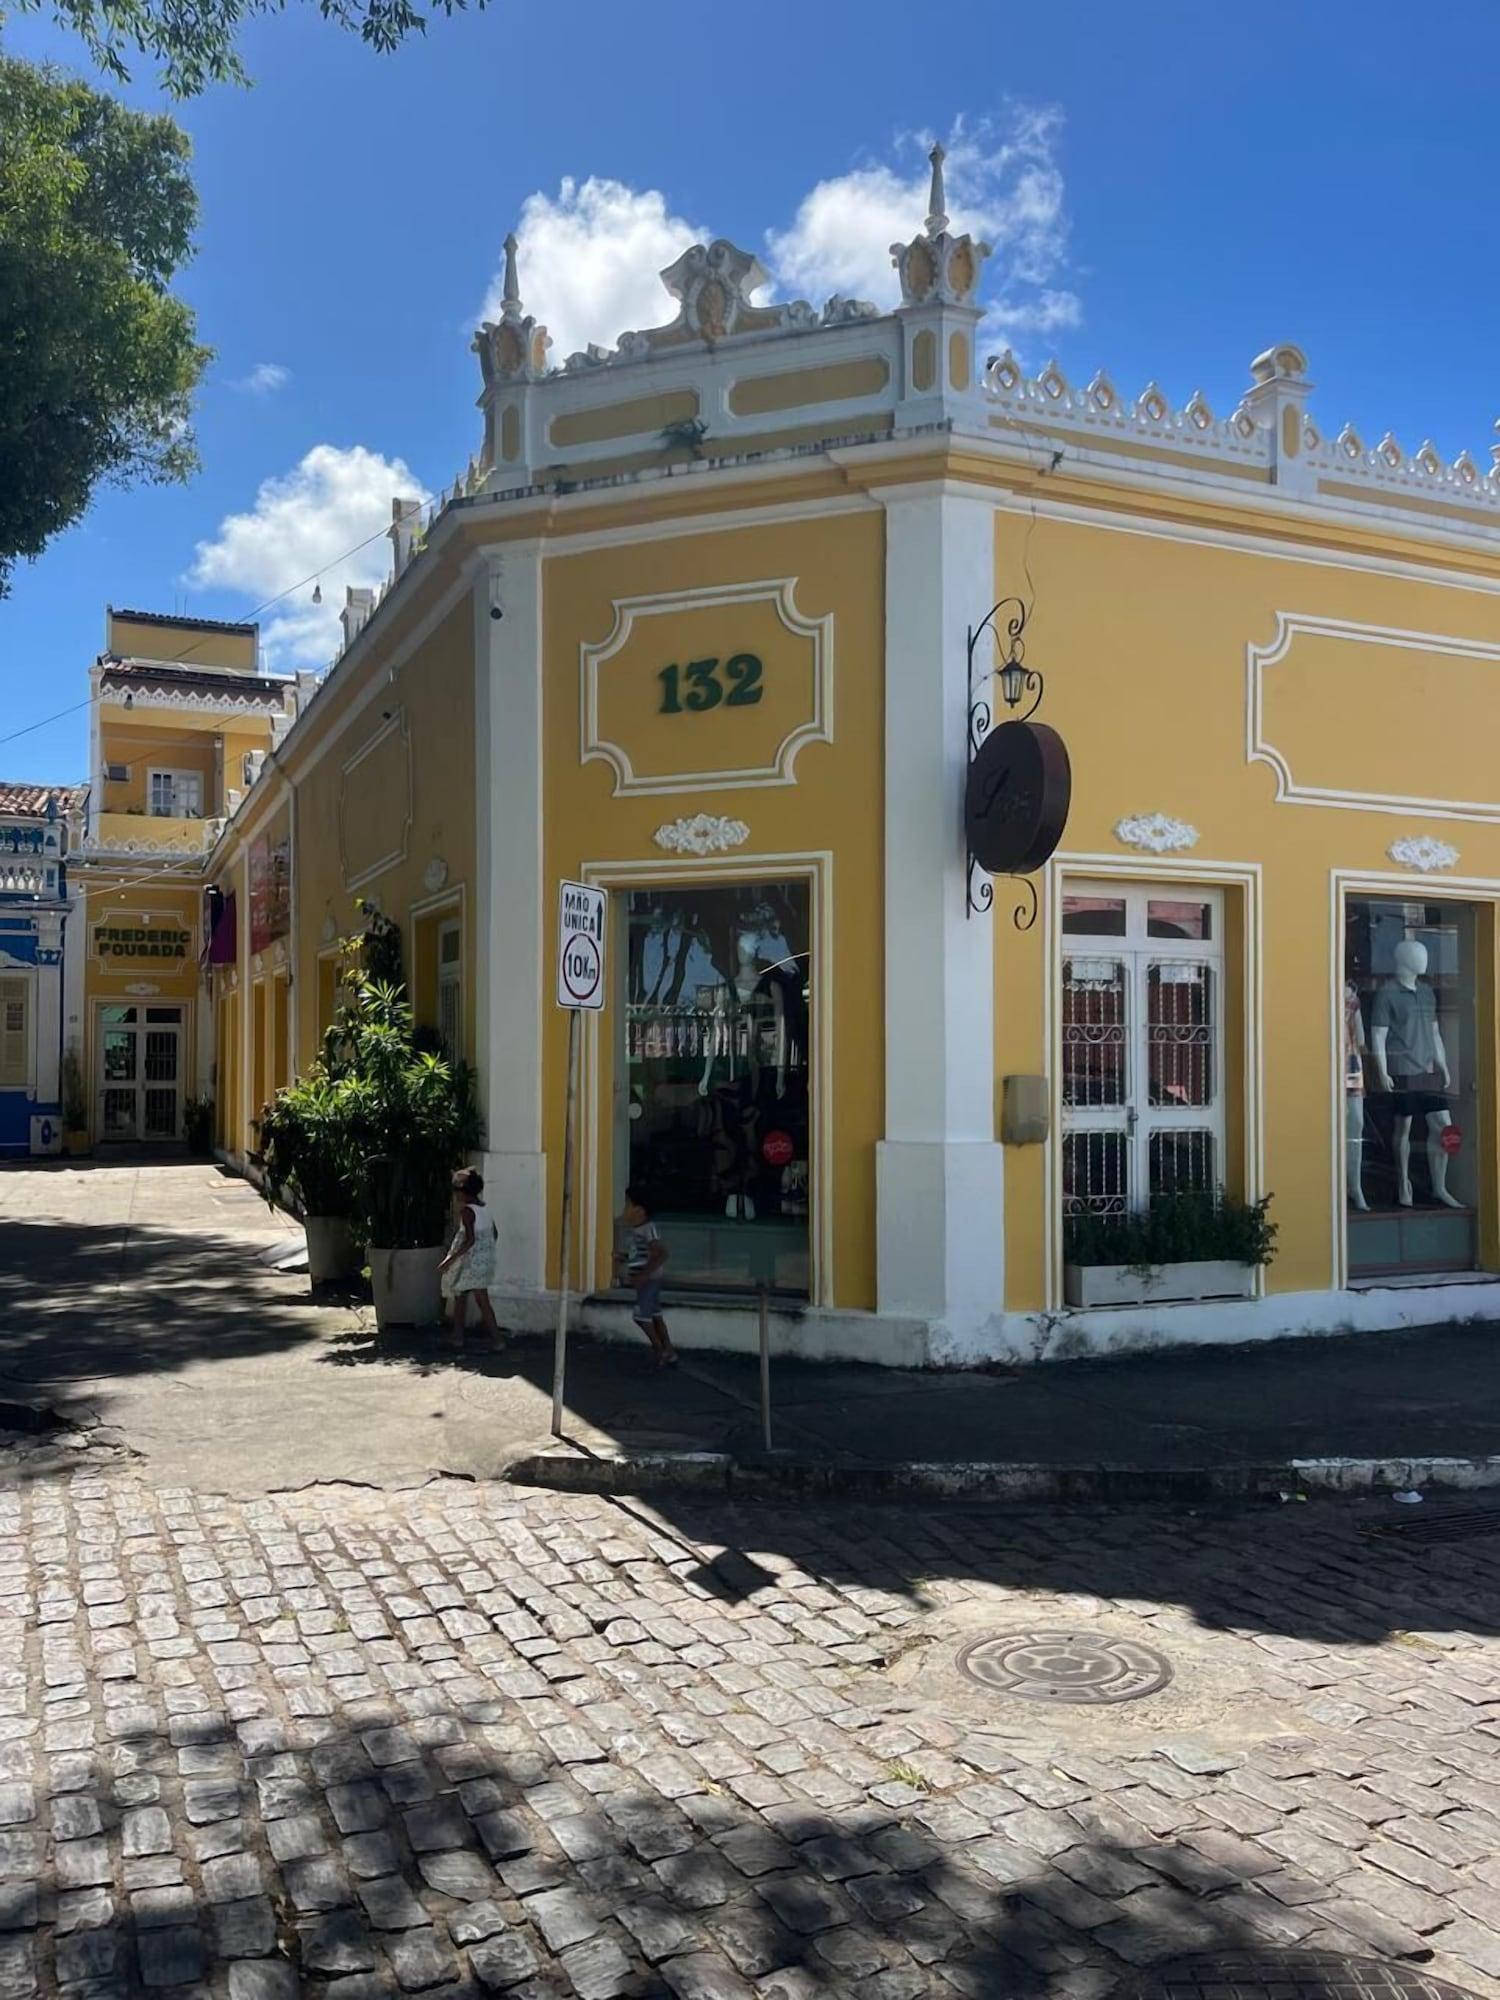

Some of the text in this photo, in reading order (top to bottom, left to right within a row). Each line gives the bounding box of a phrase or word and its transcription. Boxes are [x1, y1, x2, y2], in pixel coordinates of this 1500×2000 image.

[657, 652, 763, 714] 132
[94, 927, 191, 943] FREDERIC
[98, 942, 186, 957] POUSADA
